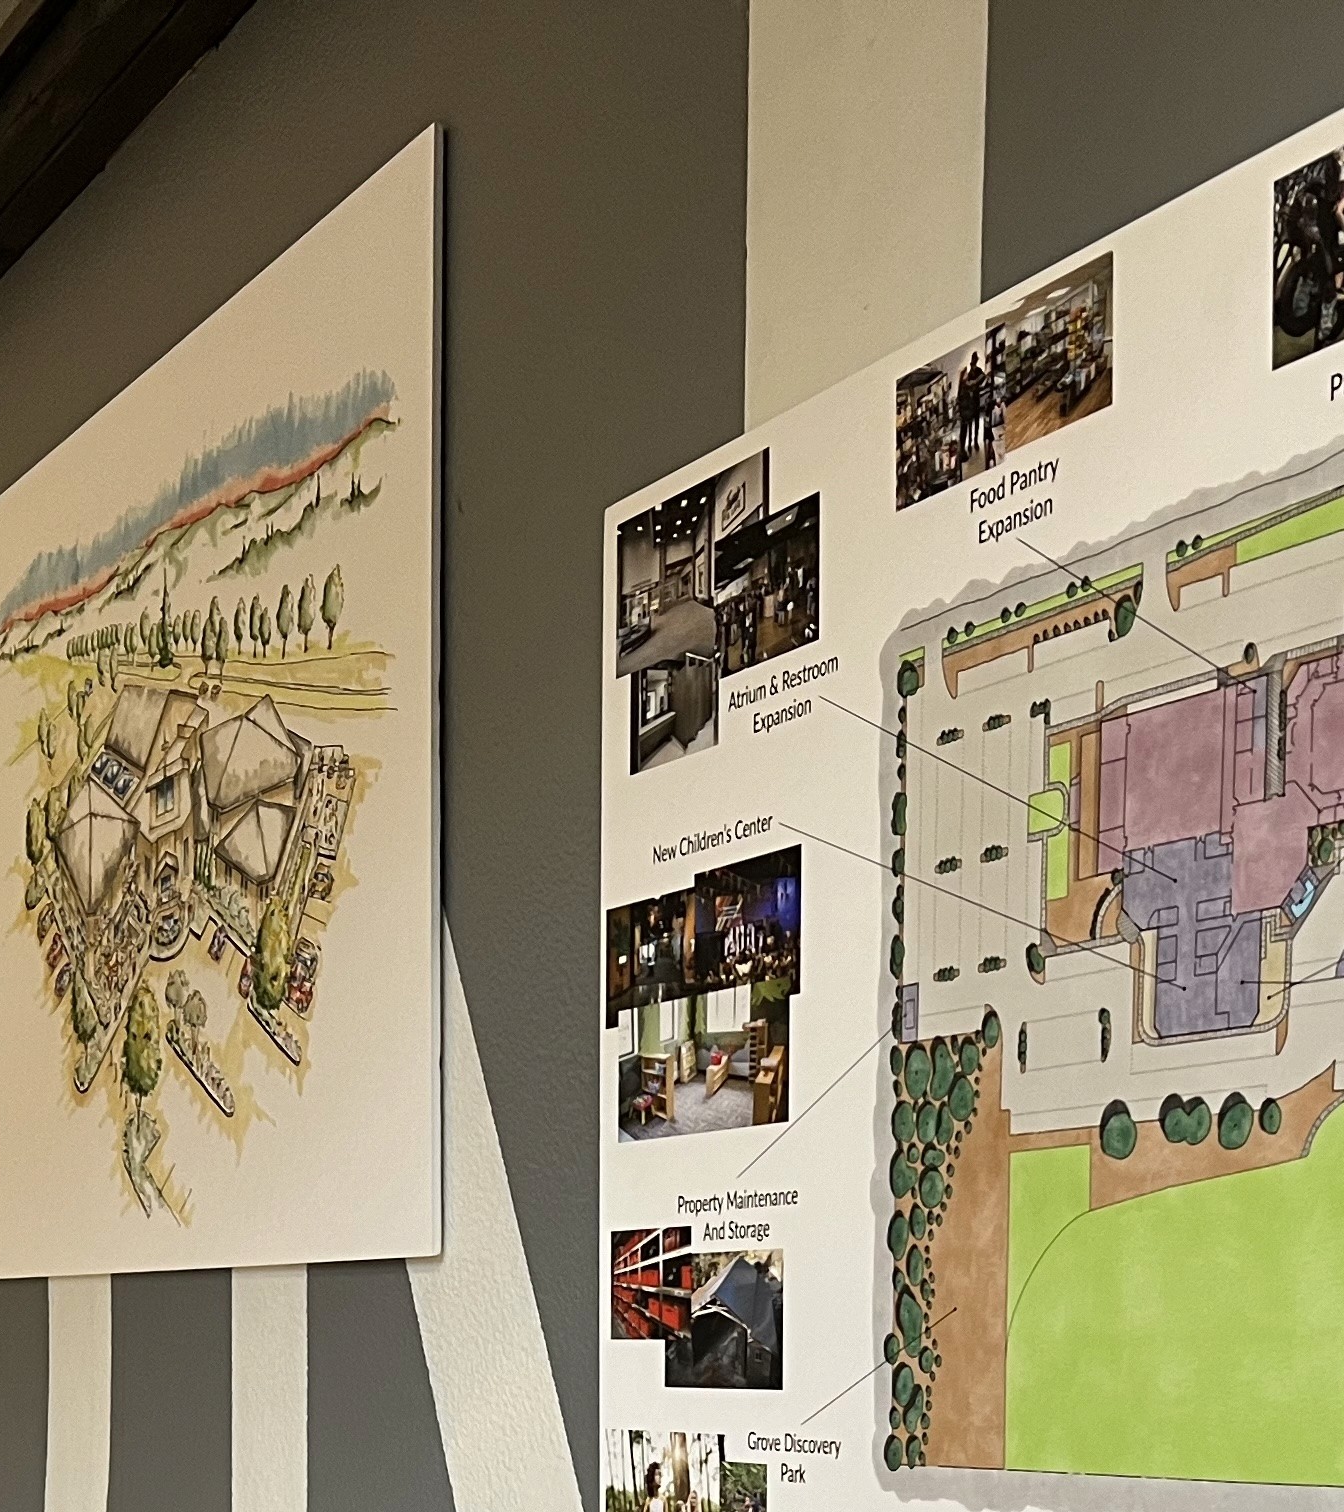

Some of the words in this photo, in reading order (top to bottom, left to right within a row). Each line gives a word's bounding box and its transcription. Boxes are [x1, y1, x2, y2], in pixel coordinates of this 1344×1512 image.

[970, 481, 1006, 513] Food
[1010, 458, 1060, 502] Pantry
[978, 496, 1054, 544] Expansion
[728, 683, 767, 712] Atrium
[769, 676, 780, 697] &
[782, 654, 839, 692] Restroom
[753, 699, 812, 733] Expansion
[652, 843, 678, 865] New
[679, 826, 732, 858] Children's
[734, 815, 774, 841] Center
[677, 1193, 724, 1217] Property
[726, 1189, 799, 1211] Maintenance
[703, 1222, 725, 1241] And
[728, 1220, 770, 1243] Storage
[747, 1432, 781, 1451] Grove
[784, 1433, 842, 1458] Discovery
[780, 1464, 806, 1483] Park
